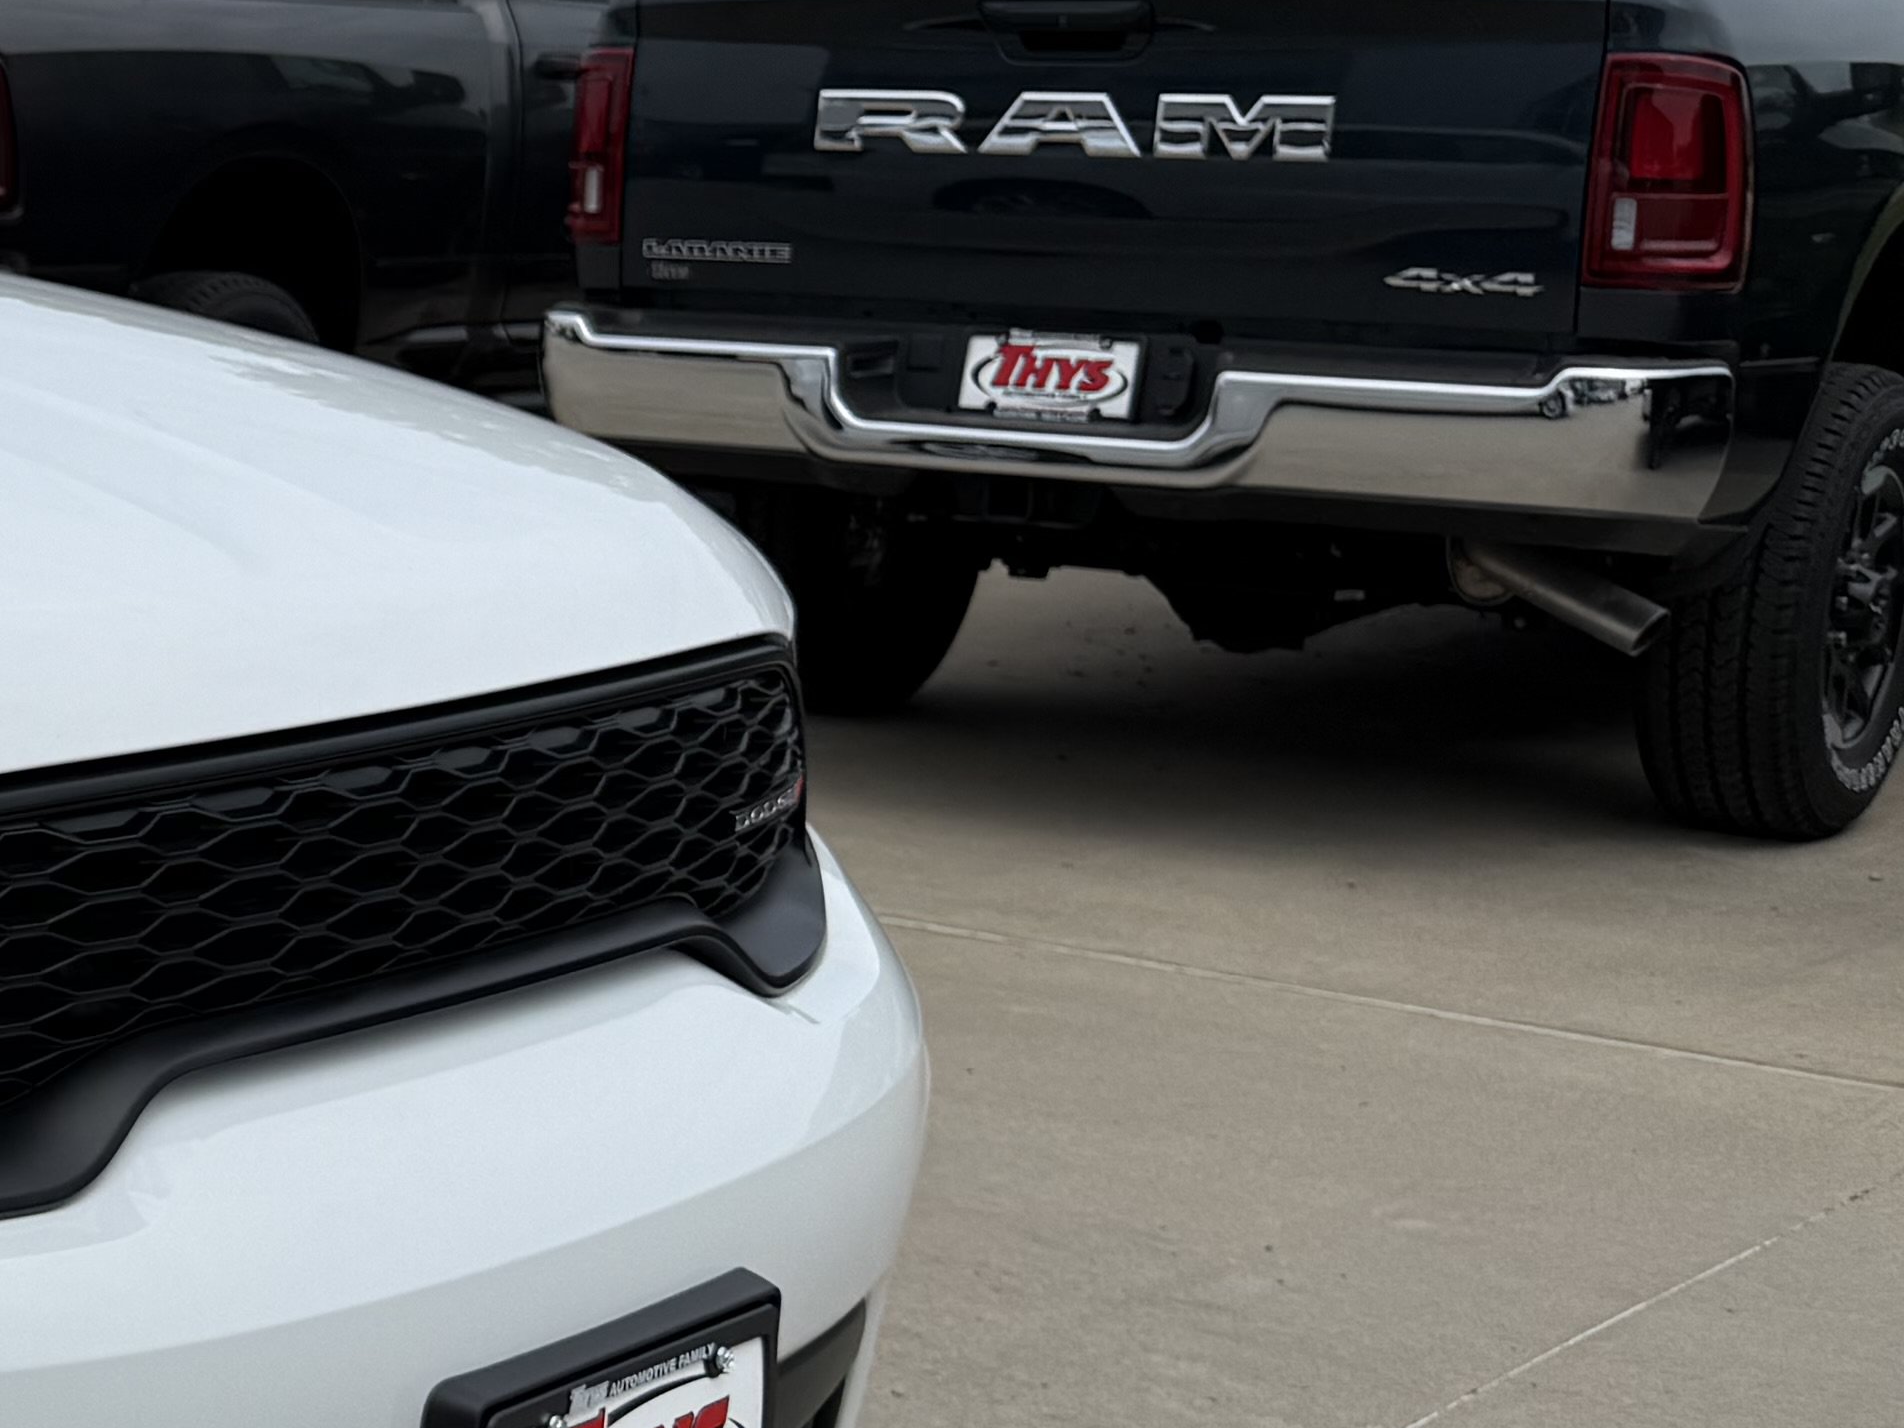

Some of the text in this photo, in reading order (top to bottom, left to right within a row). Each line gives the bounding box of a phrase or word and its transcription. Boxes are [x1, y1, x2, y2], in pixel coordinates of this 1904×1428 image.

[813, 88, 1337, 161] RAM
[609, 1357, 677, 1398] AUTOMOTIVE
[678, 1341, 717, 1370] FAMILY
